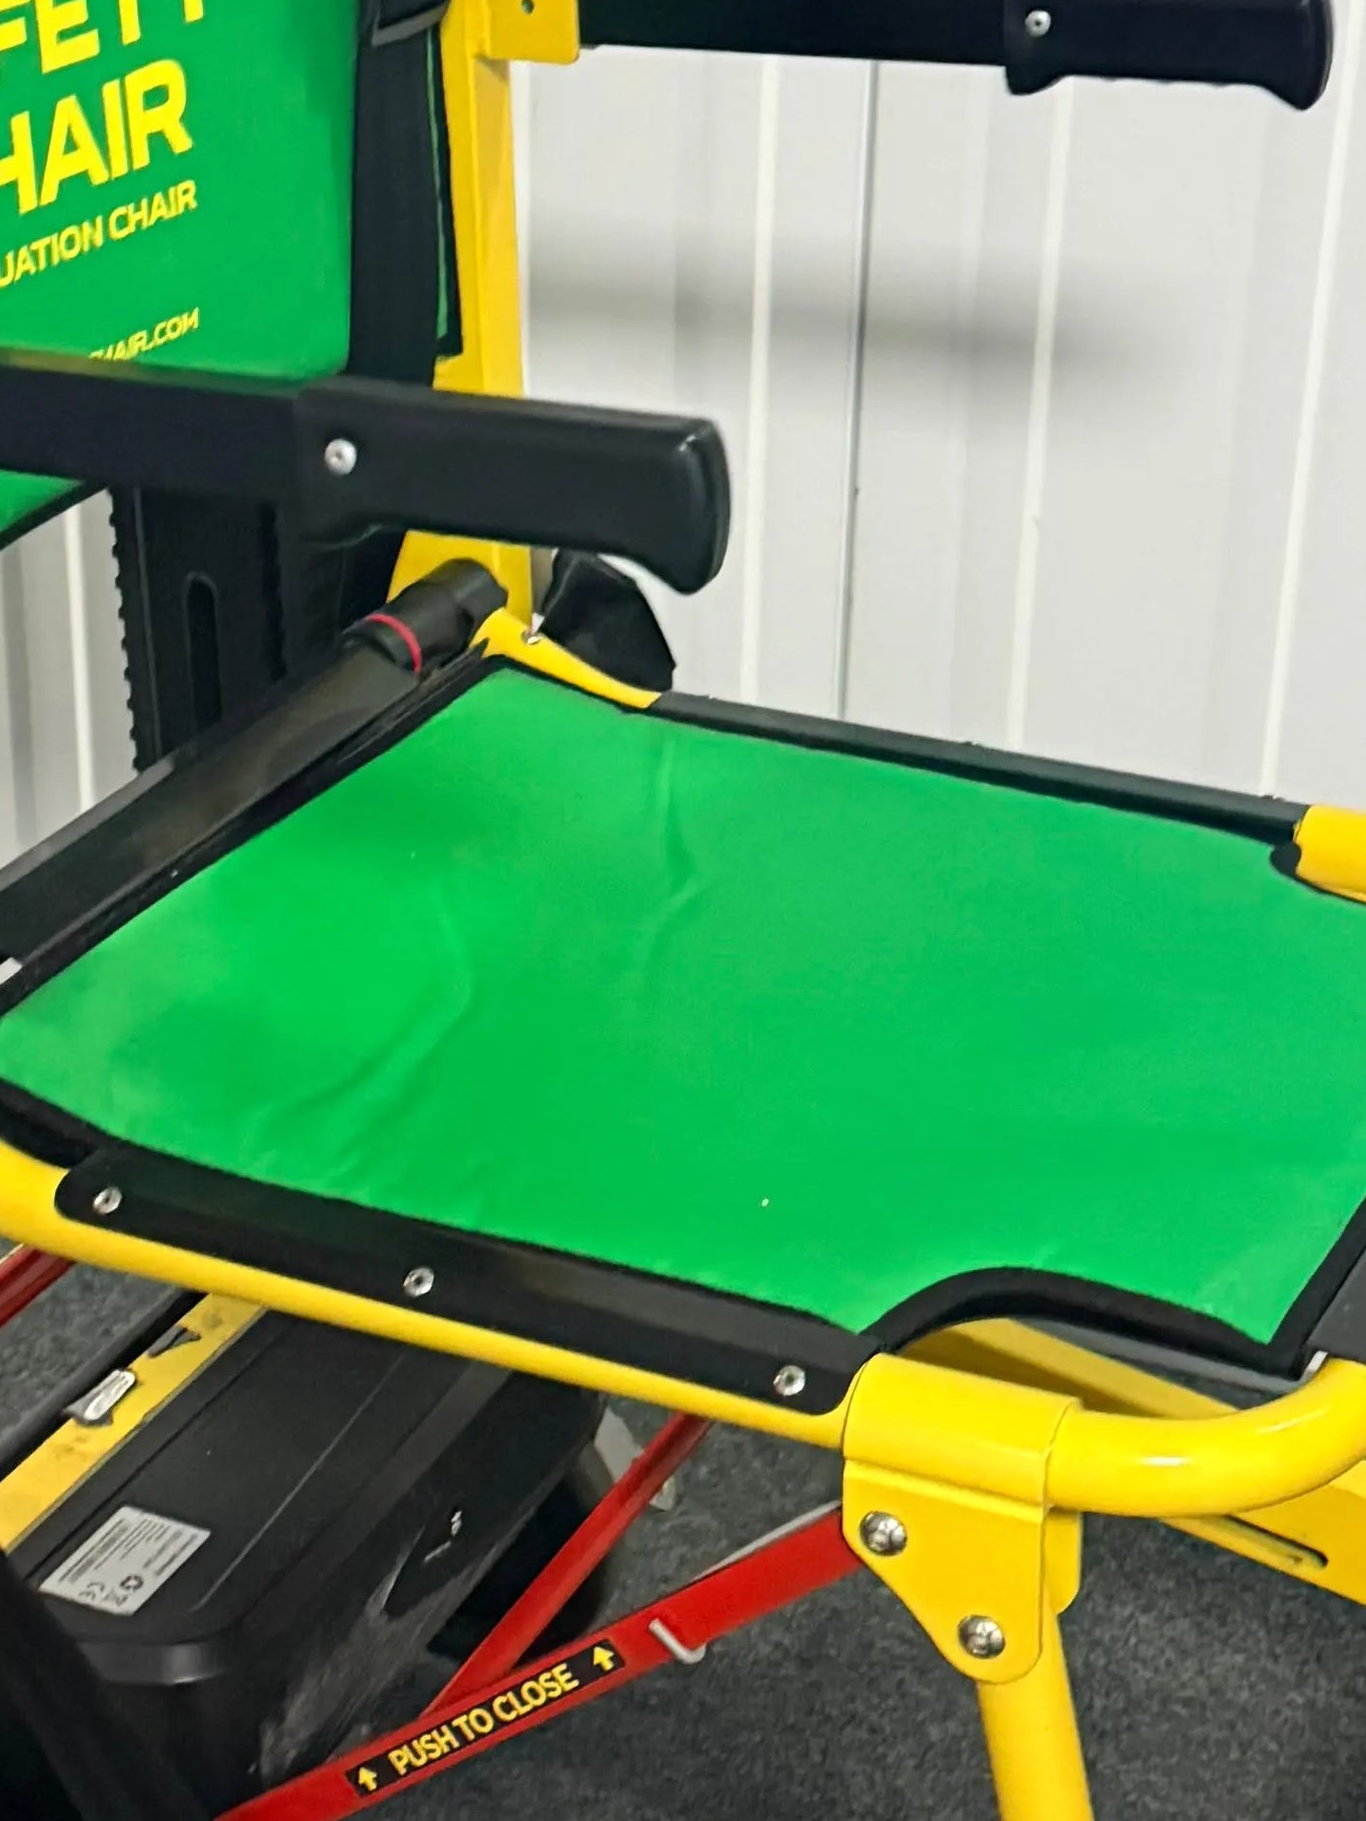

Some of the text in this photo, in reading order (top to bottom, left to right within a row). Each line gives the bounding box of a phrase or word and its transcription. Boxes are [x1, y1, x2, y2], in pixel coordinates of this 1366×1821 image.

[108, 180, 197, 240] CHAIR
[388, 1662, 580, 1776] PUSH TO CLOSE
